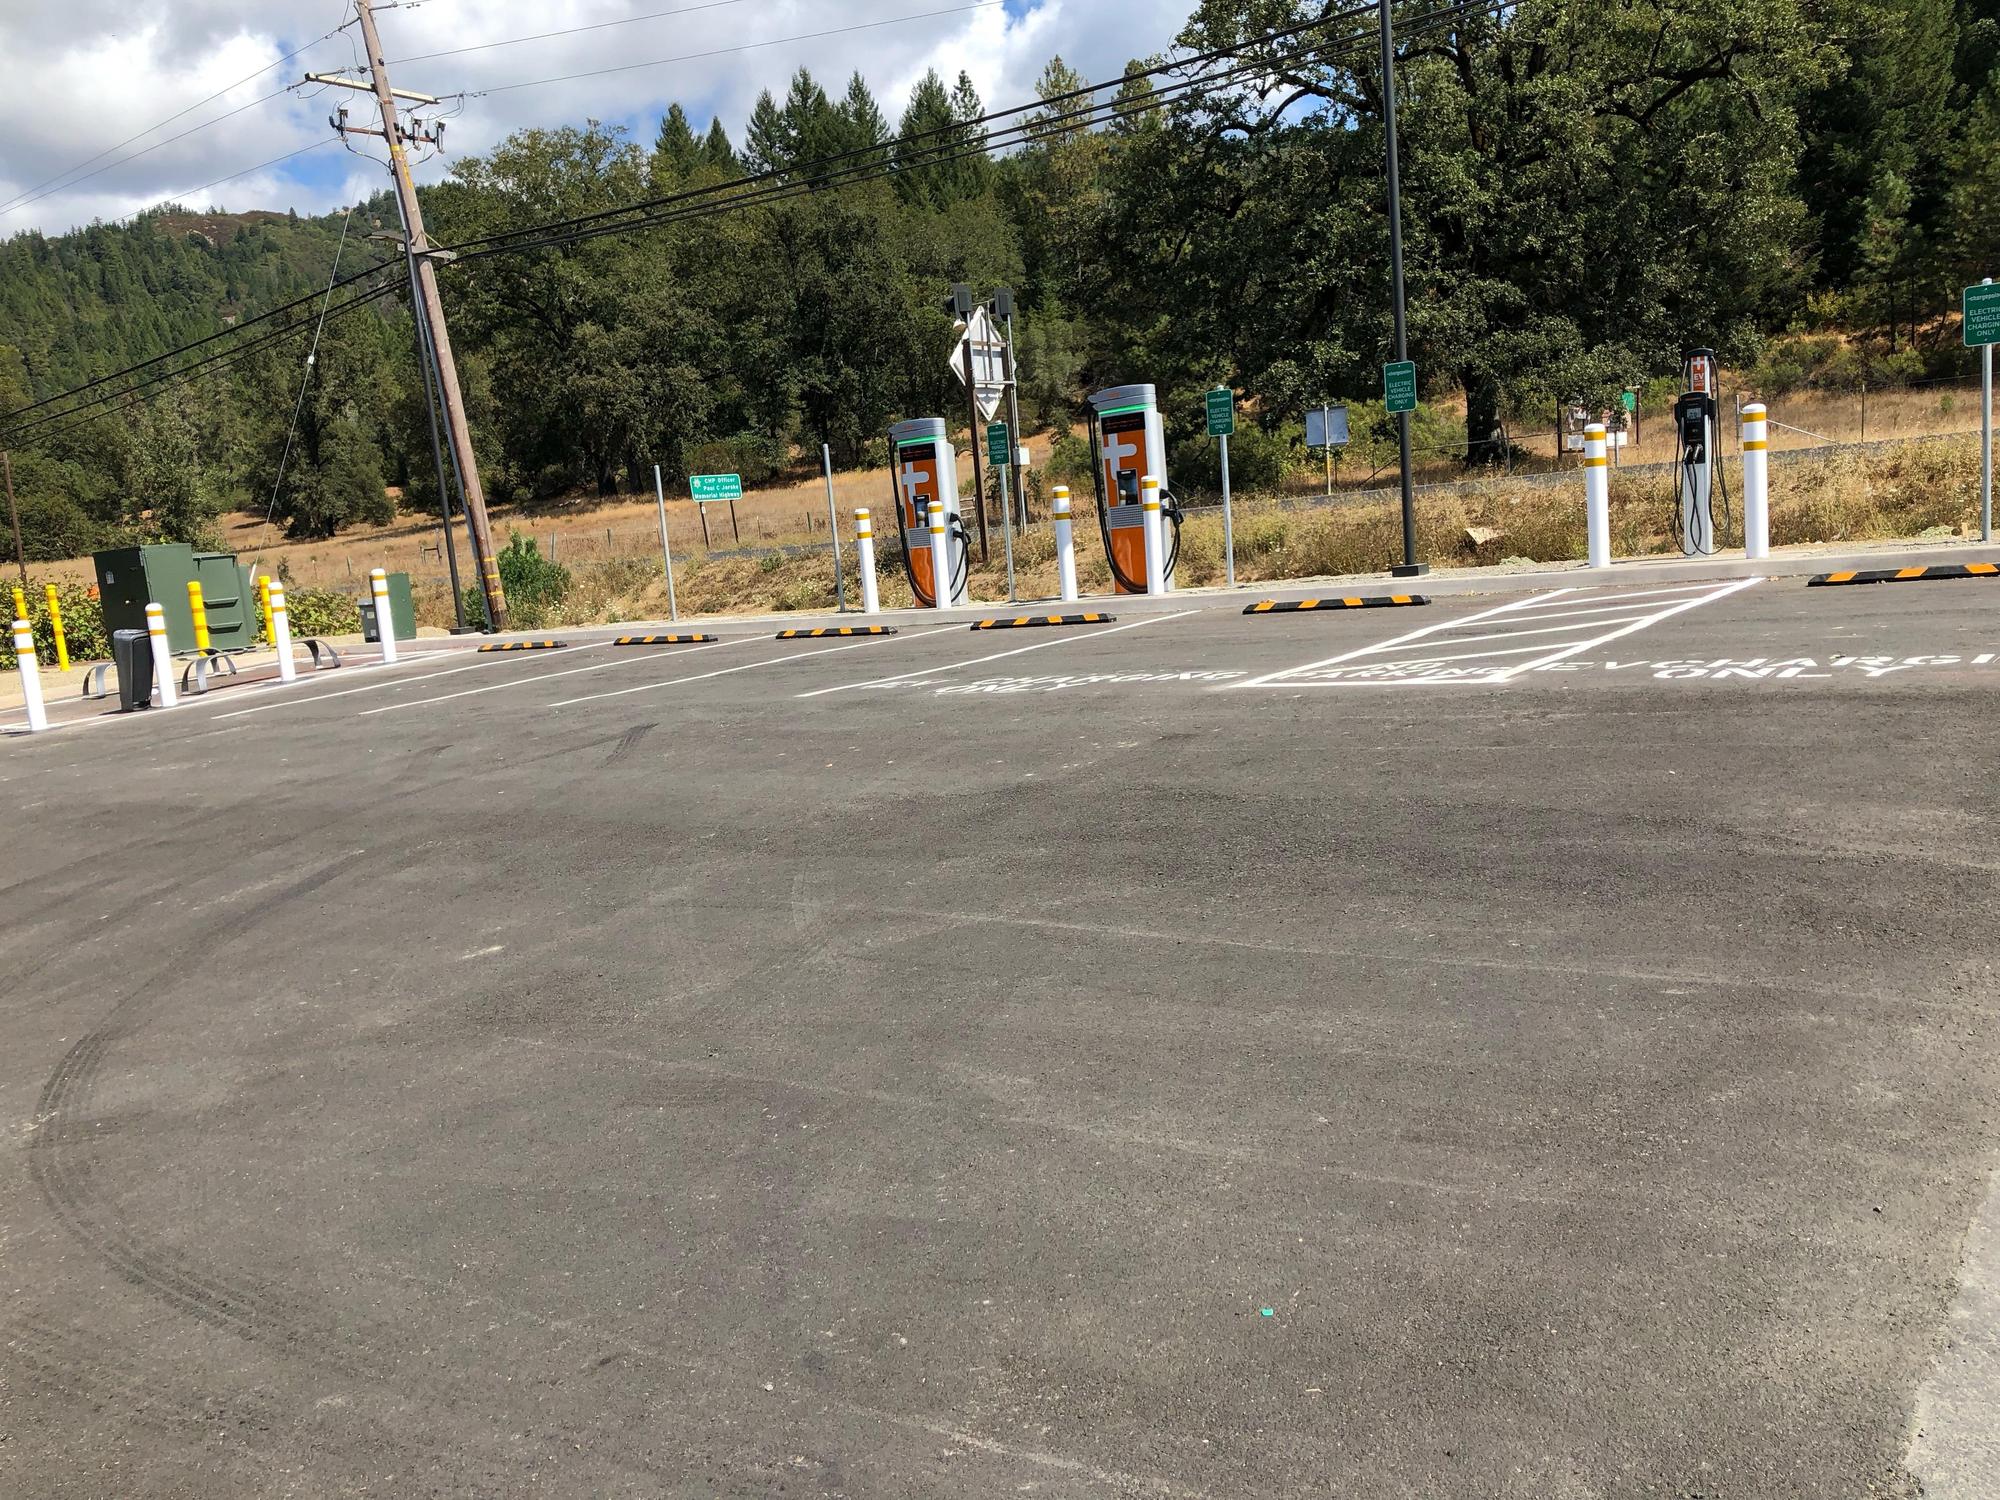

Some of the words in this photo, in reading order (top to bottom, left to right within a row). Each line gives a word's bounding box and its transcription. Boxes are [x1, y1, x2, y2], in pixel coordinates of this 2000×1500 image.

[1971, 313, 2000, 322] VEHICLE
[1967, 321, 2000, 331] CHARGIN
[1976, 328, 1996, 337] ONLY
[1388, 380, 1412, 388] ELECTRIC
[1390, 386, 1411, 394] VEHICLE
[1387, 392, 1414, 400] CHARGING
[1649, 653, 1997, 668] CHARGI
[1370, 662, 1447, 671] NO
[1277, 667, 1513, 680] PARKING
[1653, 665, 1915, 679] ONLY
[933, 682, 1088, 694] ONLY
